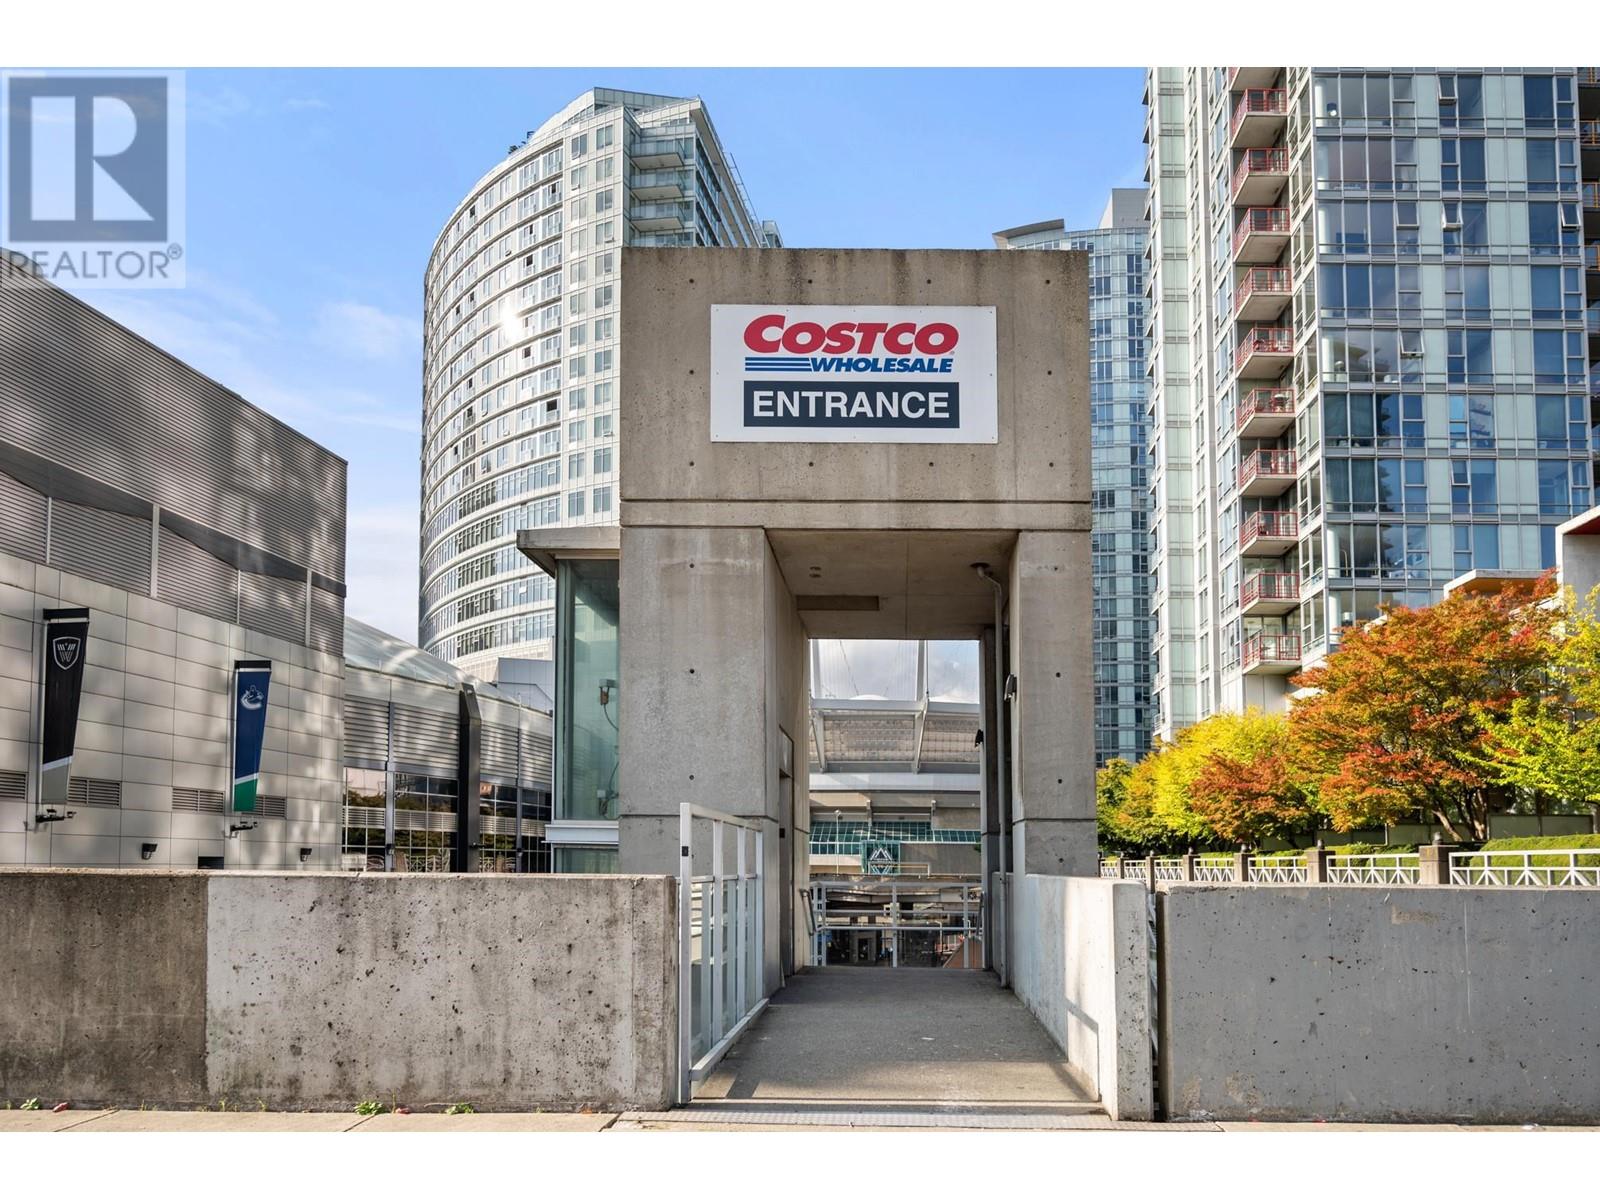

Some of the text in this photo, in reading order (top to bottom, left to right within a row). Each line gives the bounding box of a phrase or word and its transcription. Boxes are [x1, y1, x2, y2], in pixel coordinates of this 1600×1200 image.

[743, 314, 959, 355] COSTCO
[809, 357, 954, 373] WHOLESALE
[753, 391, 950, 418] ENTRANCE
